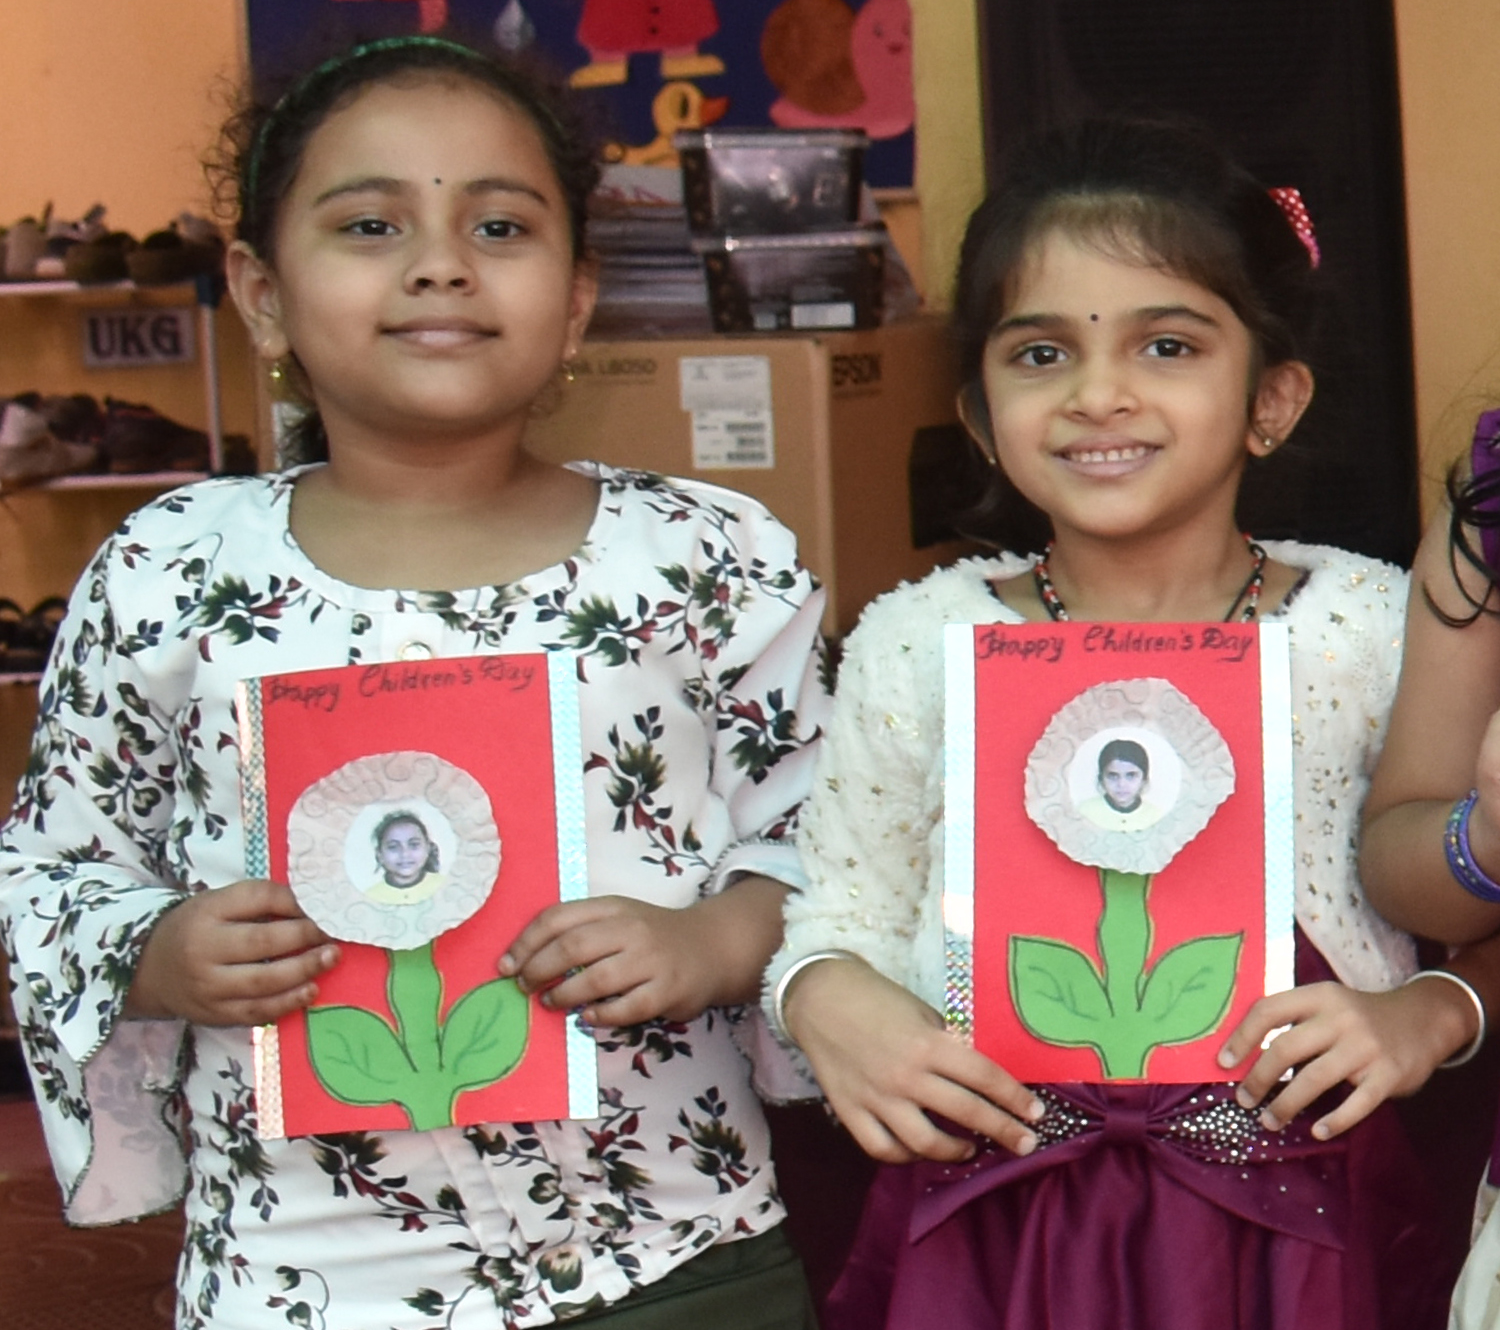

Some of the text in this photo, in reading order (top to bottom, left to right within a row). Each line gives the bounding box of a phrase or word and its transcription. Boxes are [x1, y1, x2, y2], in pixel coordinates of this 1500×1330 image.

[88, 315, 183, 359] UKG
[978, 625, 1253, 662] Happy Children's Day
[358, 663, 474, 698] Children's
[481, 656, 534, 691] Day
